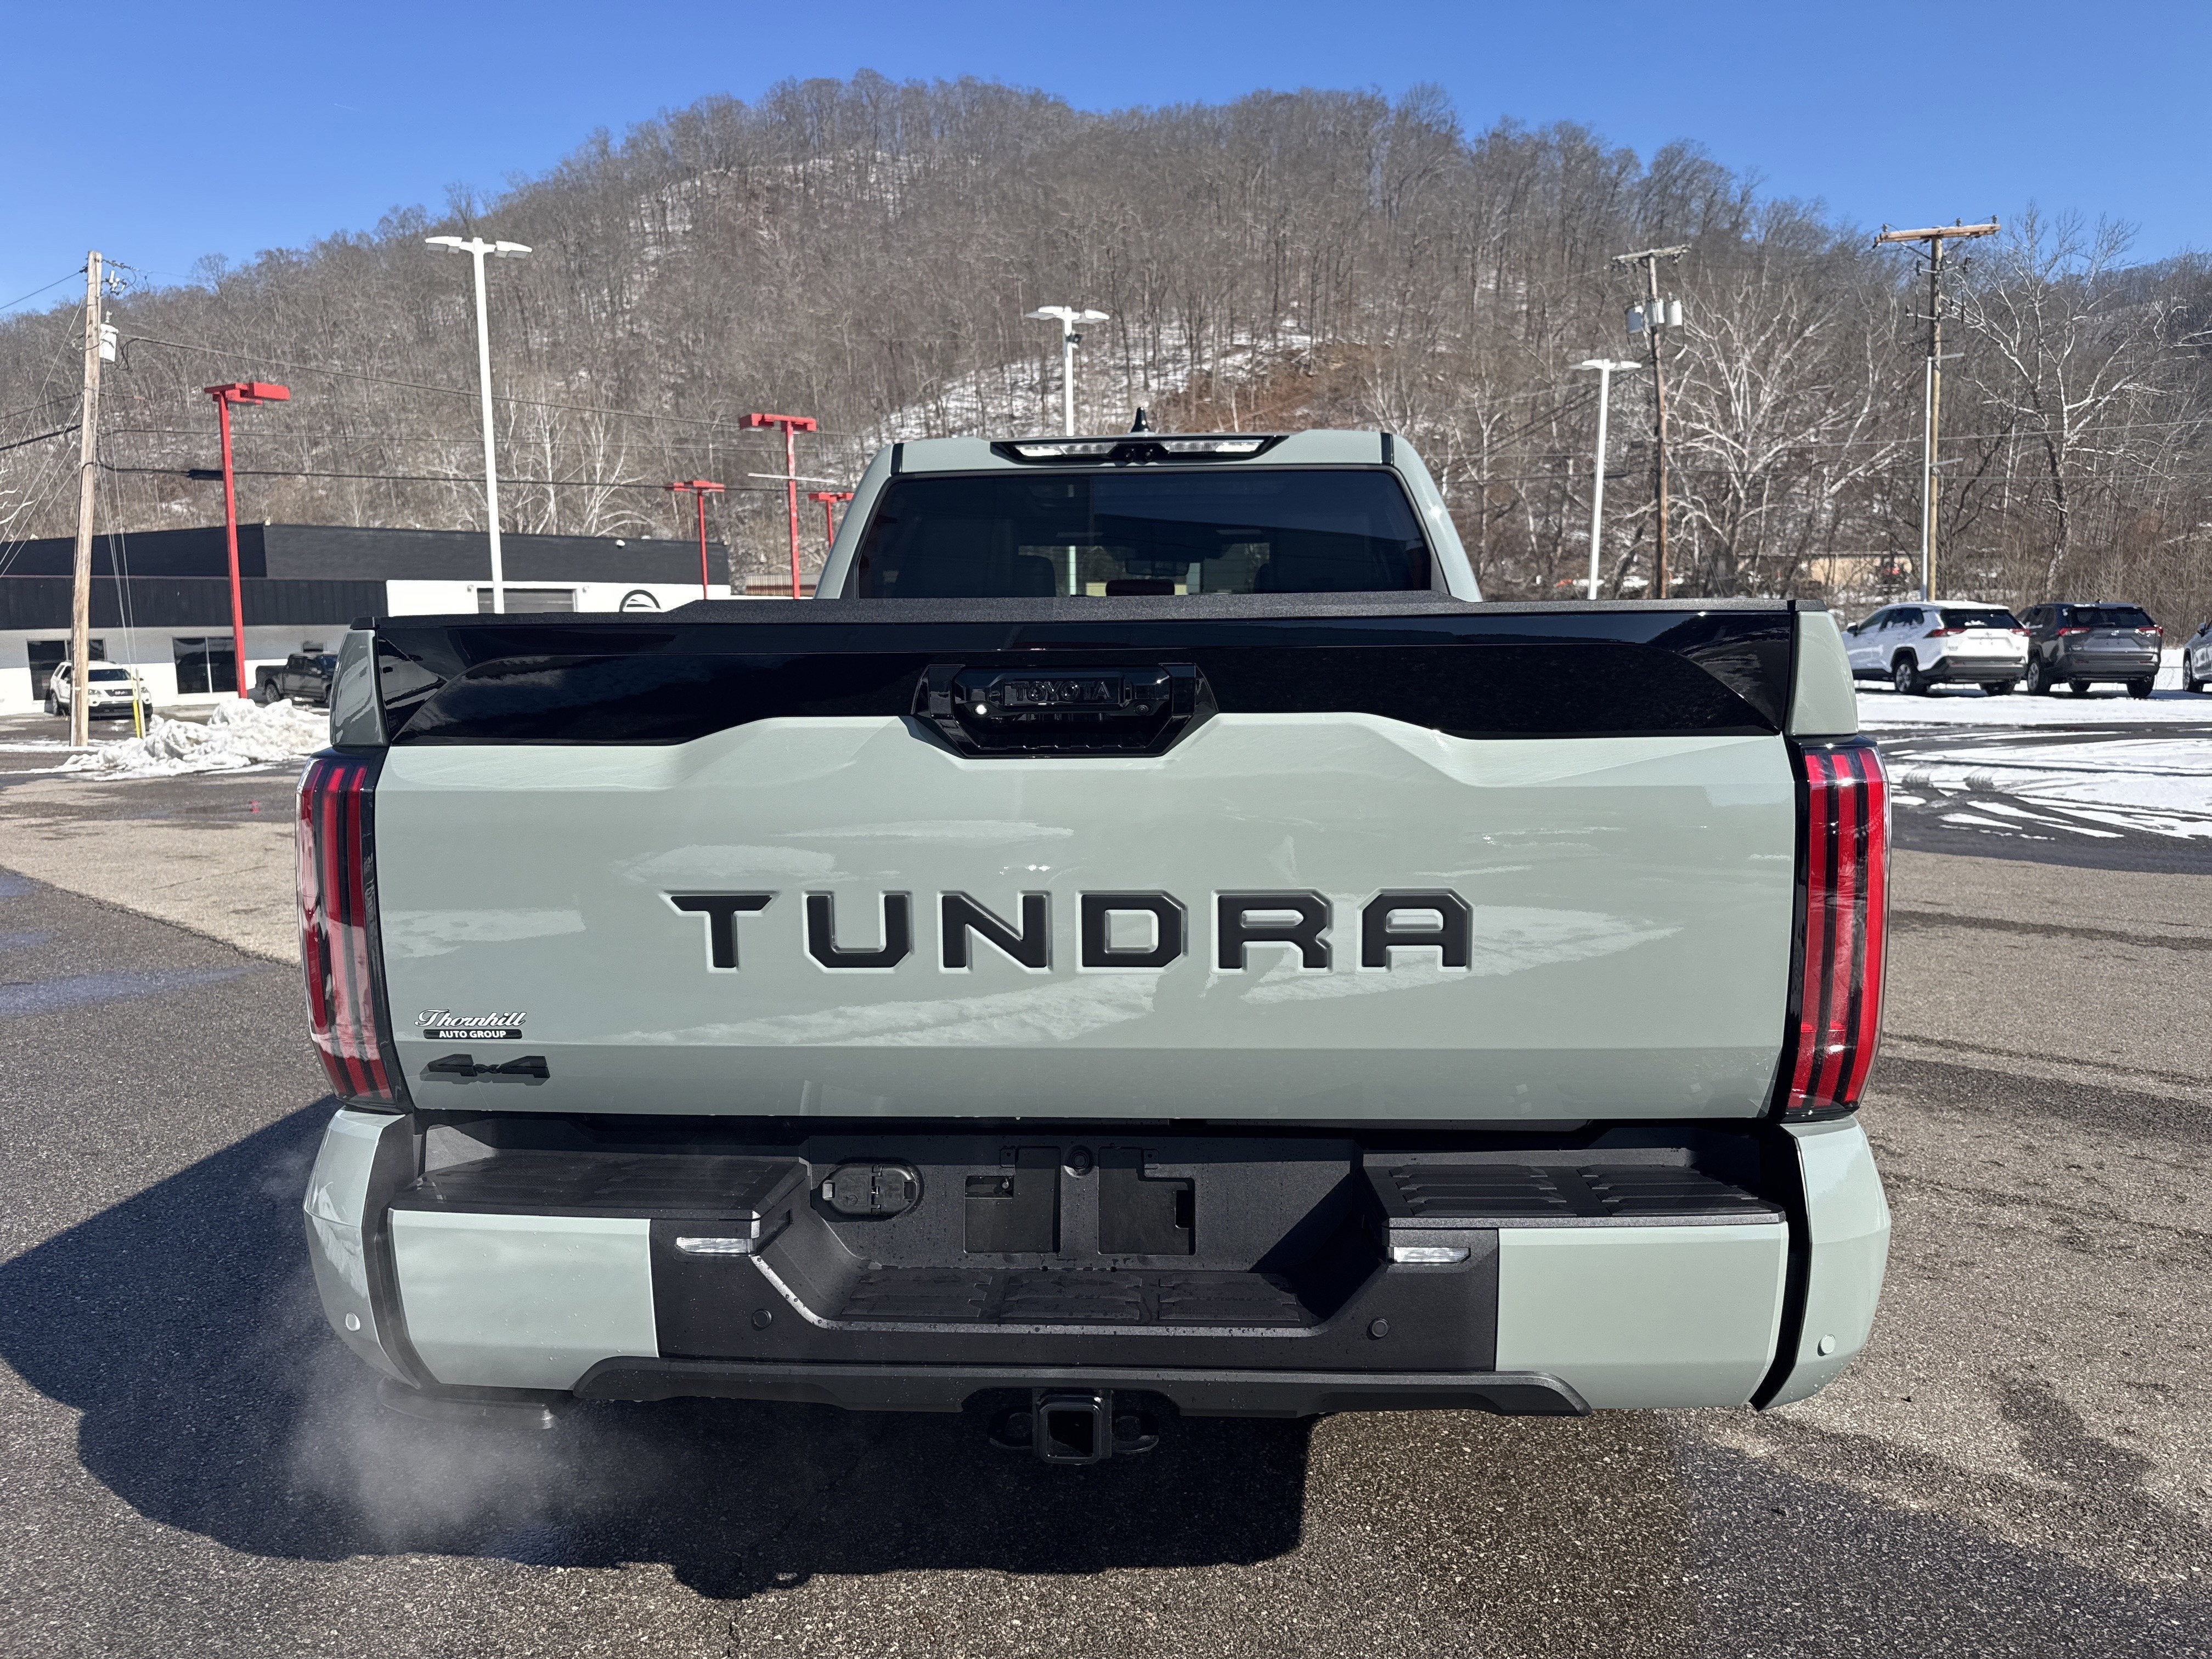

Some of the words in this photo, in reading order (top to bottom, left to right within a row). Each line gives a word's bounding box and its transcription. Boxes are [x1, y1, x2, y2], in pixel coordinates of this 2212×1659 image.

[1011, 680, 1113, 702] TOYOTA
[662, 890, 1472, 973] TUNDRA
[414, 1009, 527, 1027] Thornhill
[439, 1030, 467, 1039] AUTO
[469, 1030, 506, 1039] GROUP
